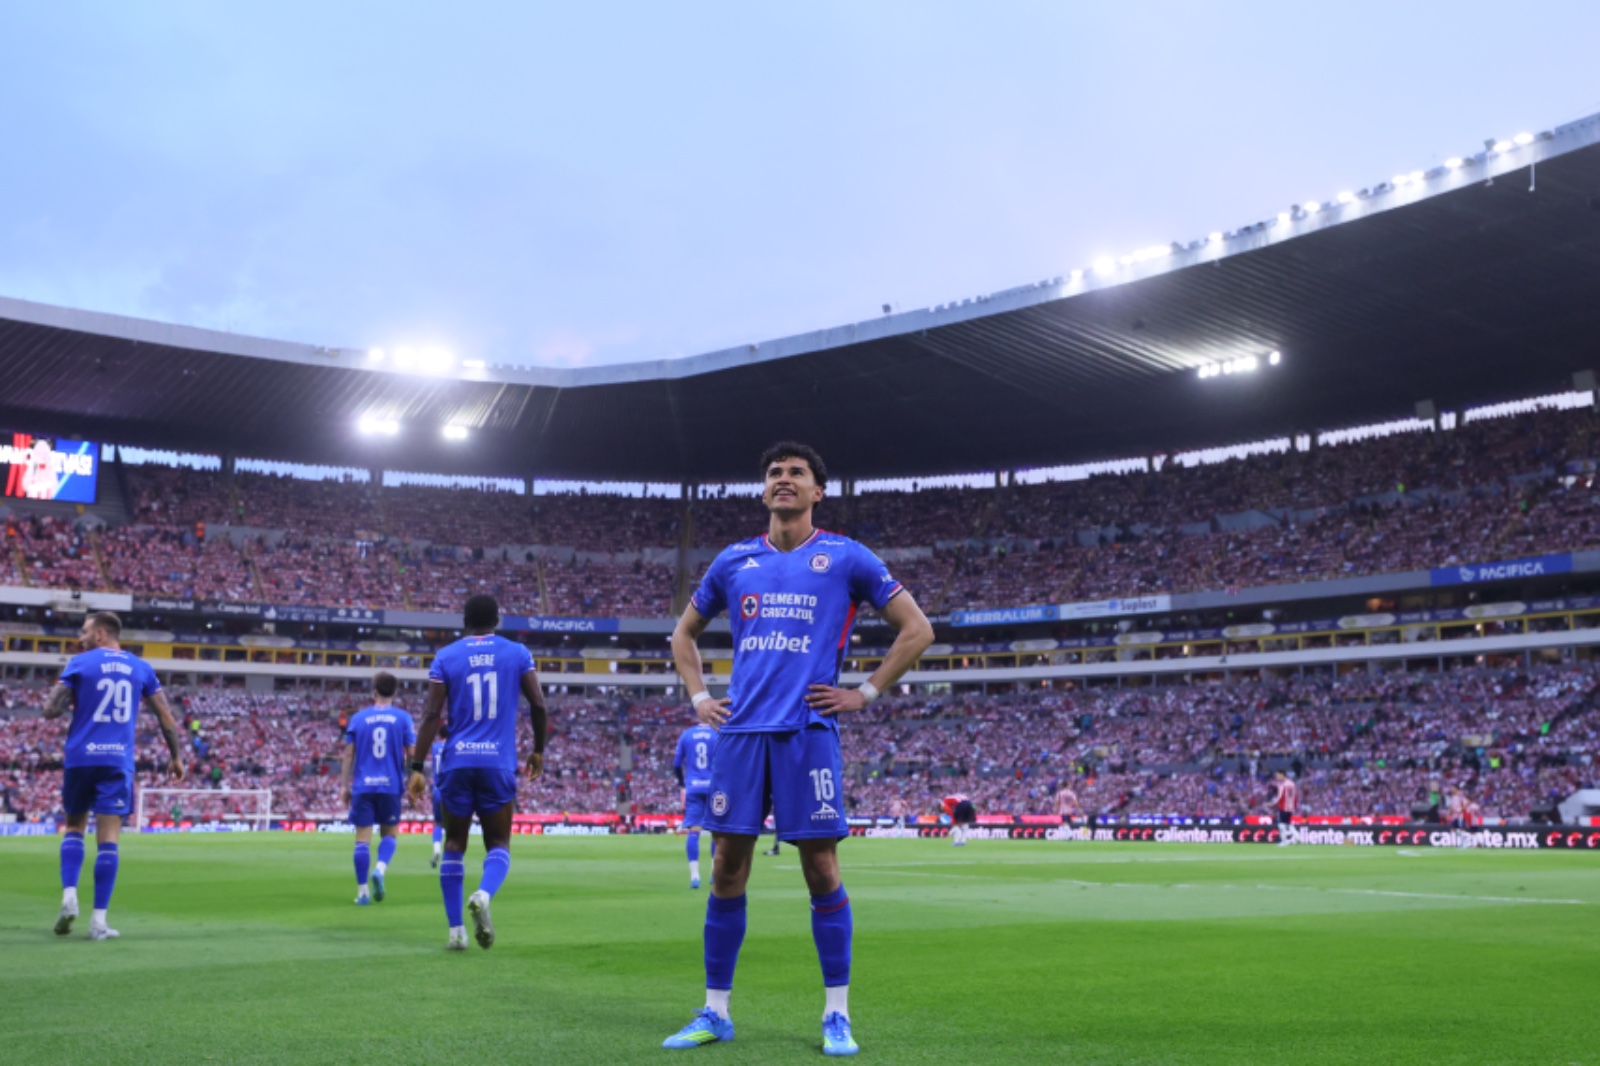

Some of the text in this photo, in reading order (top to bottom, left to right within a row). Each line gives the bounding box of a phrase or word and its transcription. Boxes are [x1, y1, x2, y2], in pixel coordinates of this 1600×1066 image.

[1480, 562, 1544, 579] PACIFICA
[762, 593, 817, 606] CEMENTO
[964, 608, 1042, 624] HERRALUM
[543, 620, 595, 631] PACIFICA
[93, 678, 132, 723] 29
[466, 671, 497, 720] 11
[372, 727, 387, 759] 8
[809, 768, 834, 801] 16
[543, 823, 609, 835] caliente.mx
[1154, 826, 1234, 842] caliente.mx
